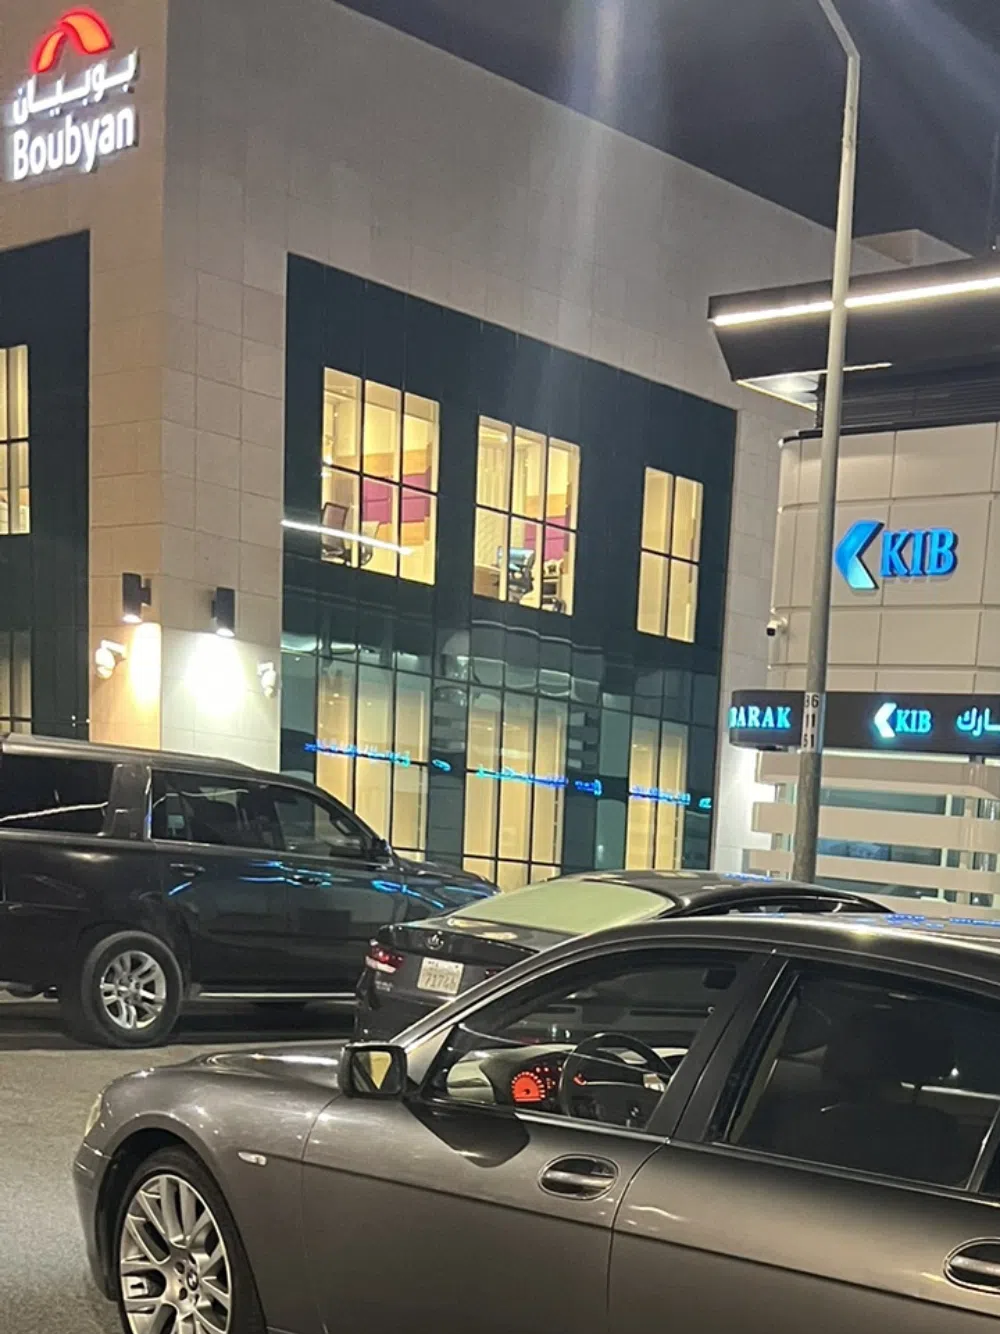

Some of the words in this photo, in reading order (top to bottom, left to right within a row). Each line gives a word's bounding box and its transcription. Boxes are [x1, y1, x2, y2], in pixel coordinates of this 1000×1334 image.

[12, 49, 138, 125] بوبيان
[12, 106, 137, 181] Boubyan
[880, 527, 959, 577] KIB
[895, 709, 931, 733] KIB
